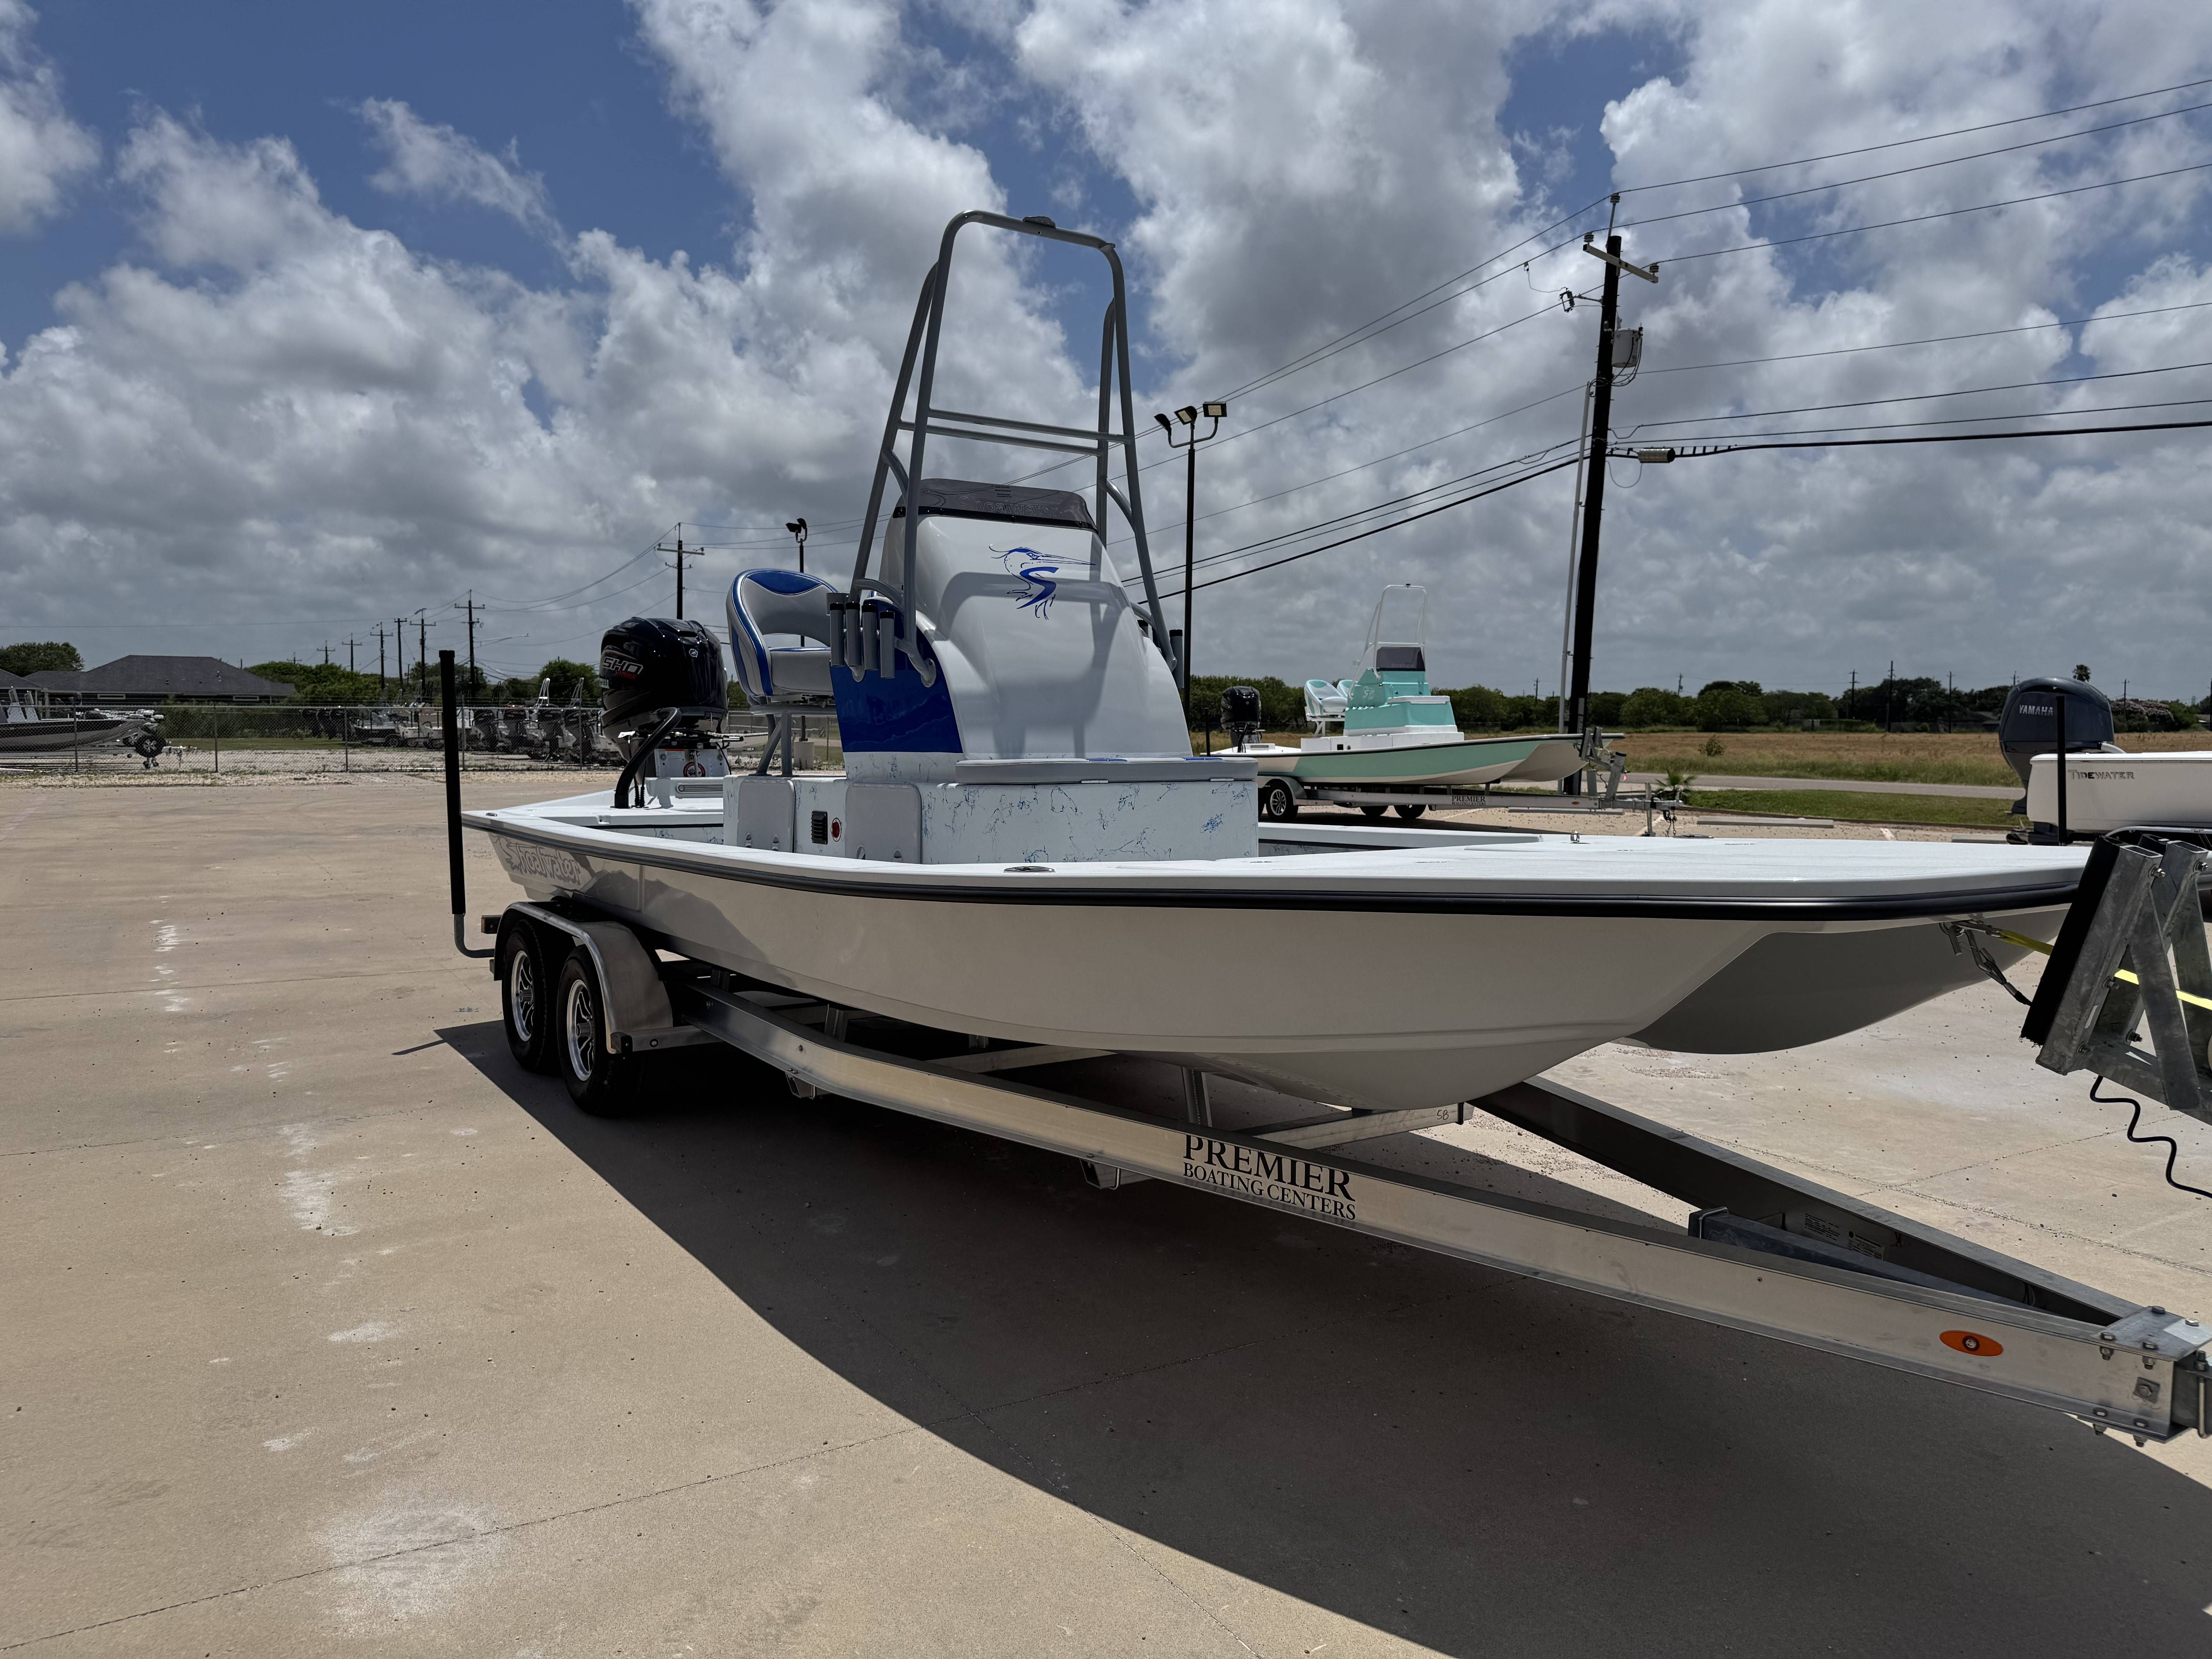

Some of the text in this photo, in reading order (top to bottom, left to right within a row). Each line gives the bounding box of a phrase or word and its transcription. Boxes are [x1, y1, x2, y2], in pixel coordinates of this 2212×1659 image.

[959, 496, 1058, 517] Shoalwater
[602, 656, 644, 675] SHO
[2019, 704, 2053, 716] YAMAHA
[500, 838, 581, 886] Shoalwater
[1183, 1134, 1356, 1202] PREMIER
[1183, 1162, 1356, 1220] BOATING CENTERS
